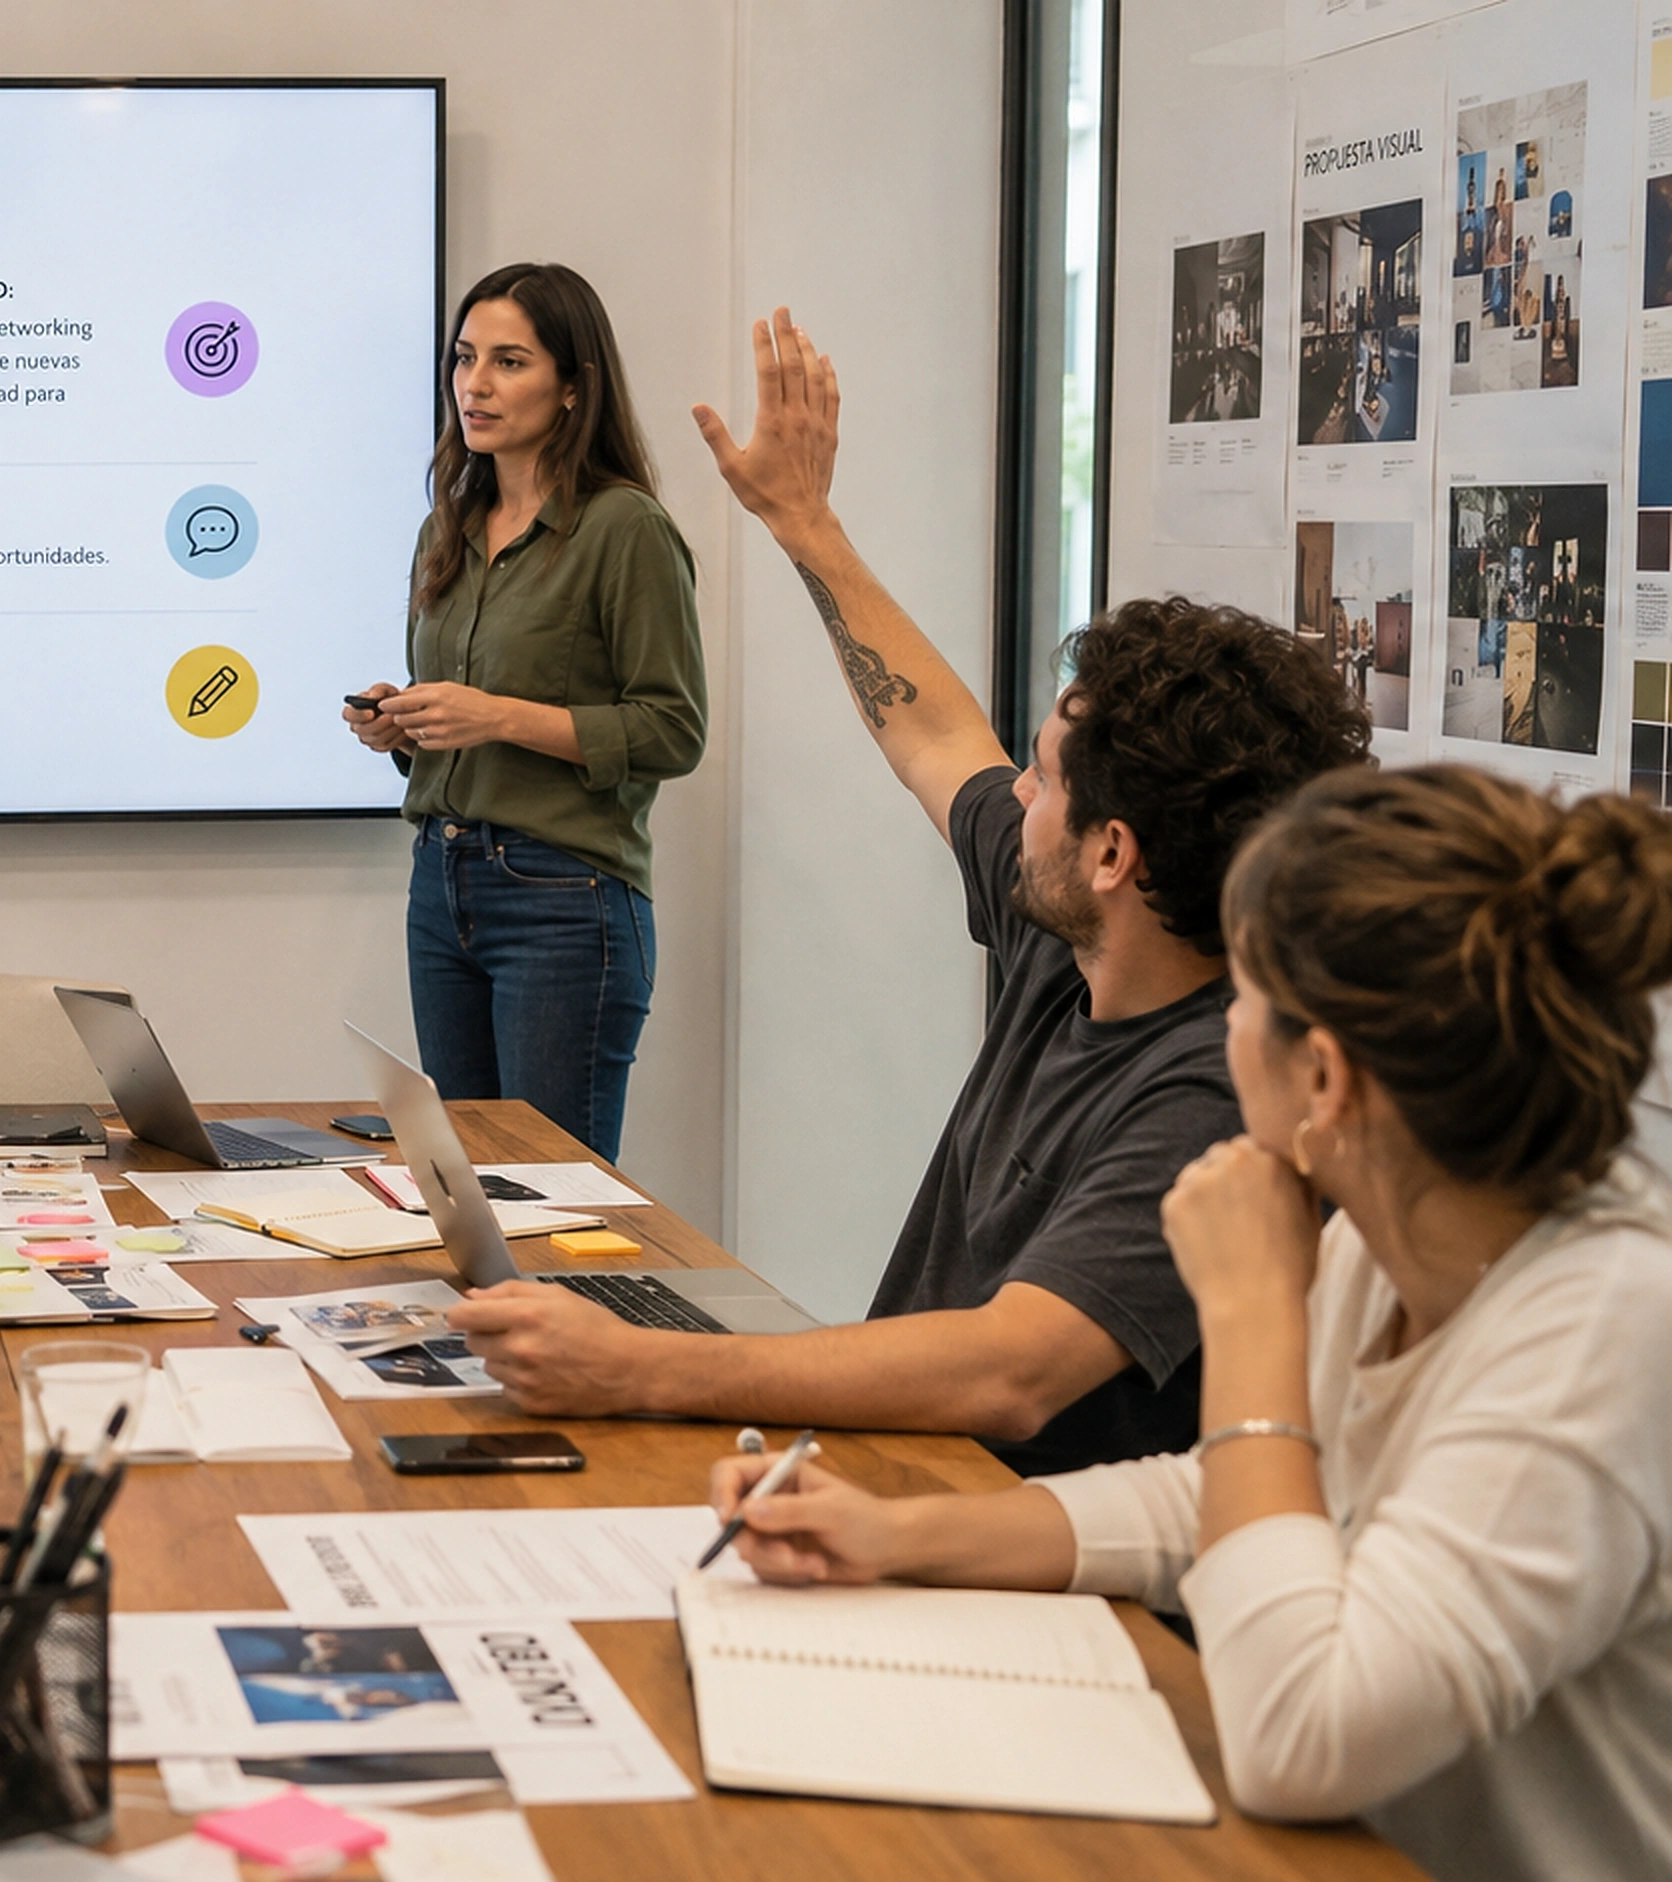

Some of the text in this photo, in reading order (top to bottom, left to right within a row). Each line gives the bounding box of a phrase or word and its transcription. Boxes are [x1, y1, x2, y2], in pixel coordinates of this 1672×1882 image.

[1303, 128, 1424, 177] PROPUESTA VISUAL
[15, 355, 81, 370] nuevas
[25, 388, 66, 407] para
